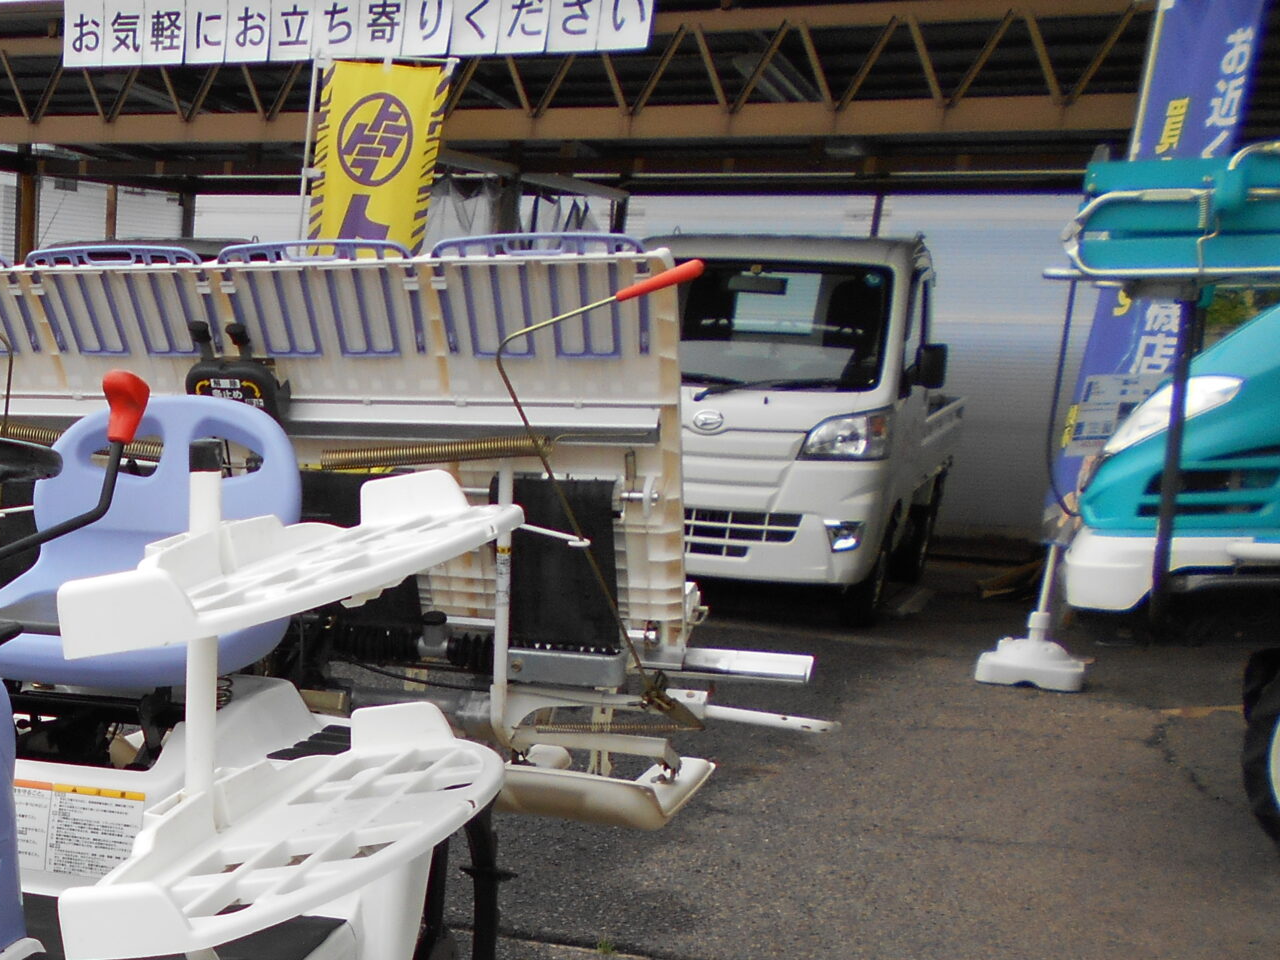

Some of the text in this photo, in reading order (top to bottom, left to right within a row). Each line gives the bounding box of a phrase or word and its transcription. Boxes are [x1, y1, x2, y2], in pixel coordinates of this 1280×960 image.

[72, 0, 646, 53] お気軽にお立ち寄りください
